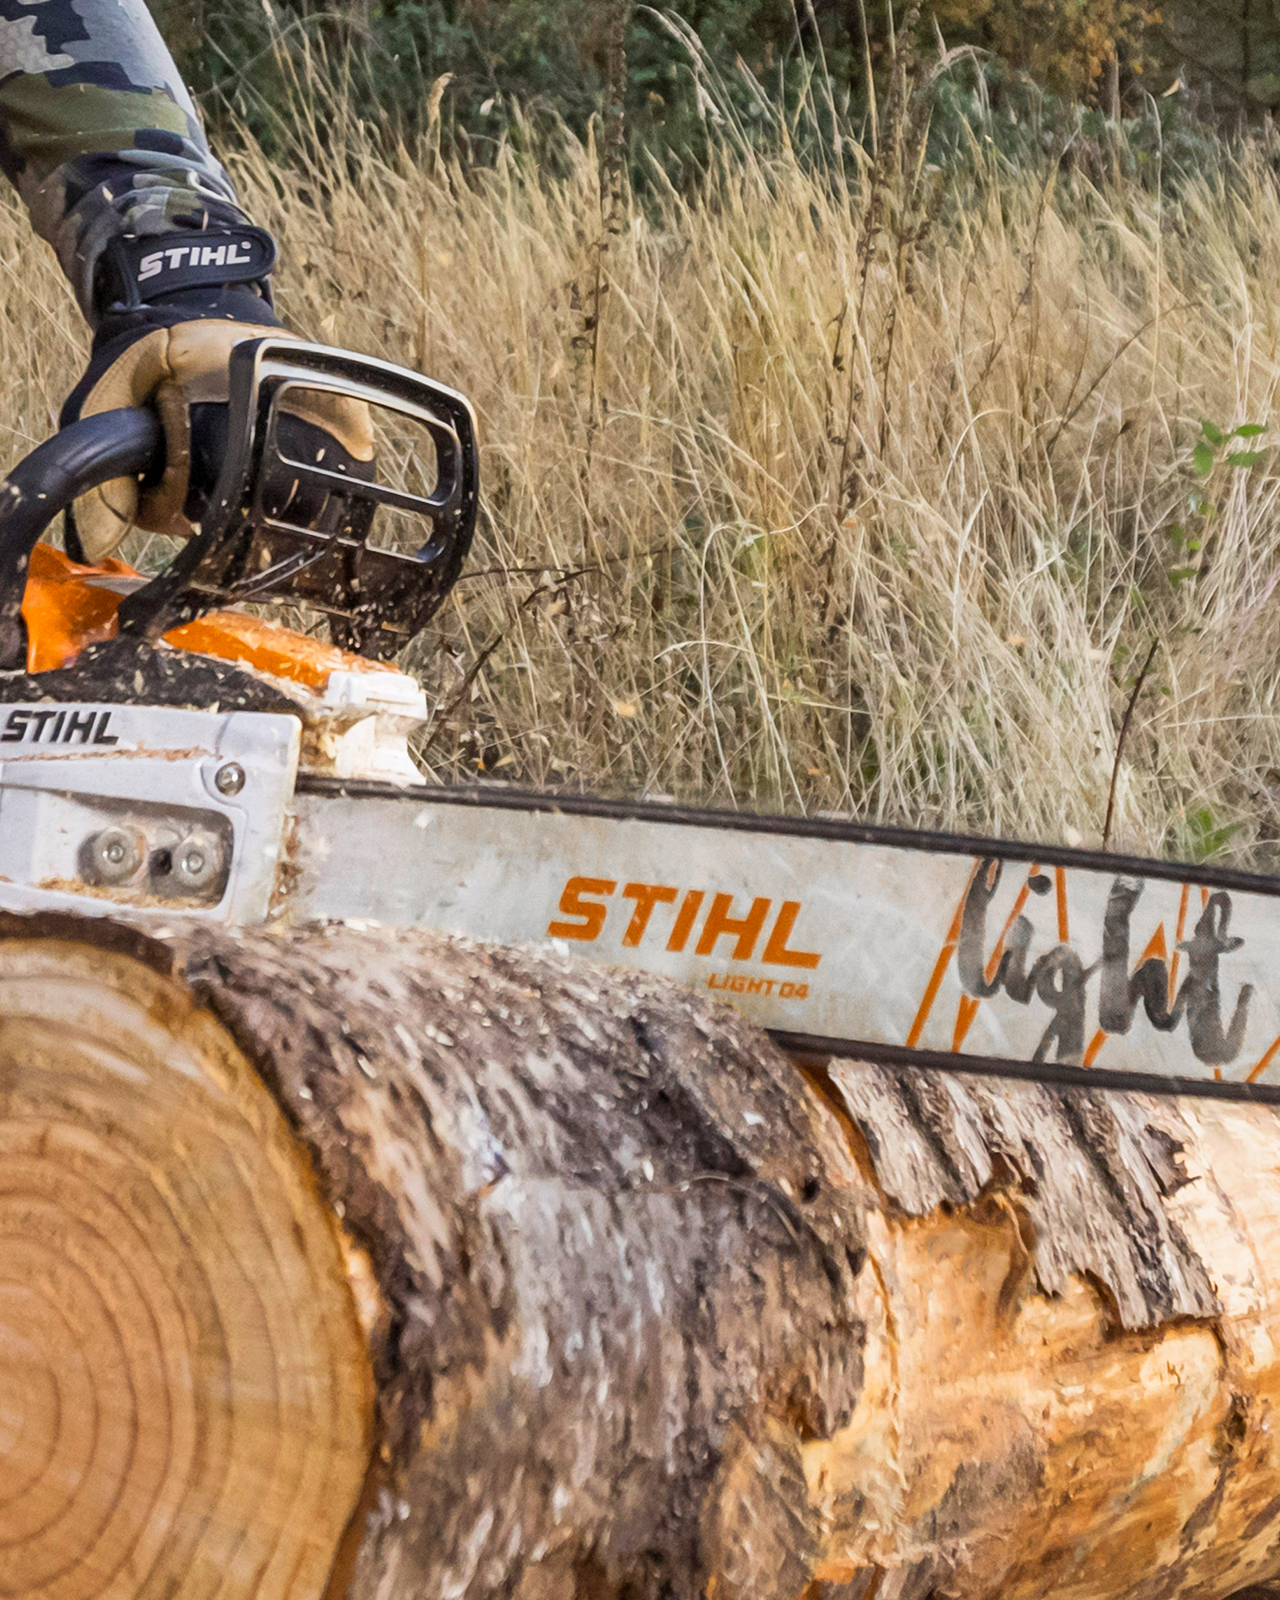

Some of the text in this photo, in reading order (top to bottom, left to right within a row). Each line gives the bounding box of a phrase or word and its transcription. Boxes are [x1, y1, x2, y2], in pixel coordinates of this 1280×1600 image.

[137, 243, 251, 281] STIHL
[0, 710, 120, 745] STIHL
[547, 875, 822, 970] STIHL
[957, 857, 1255, 1066] light
[706, 972, 810, 1000] LIGHT 04
